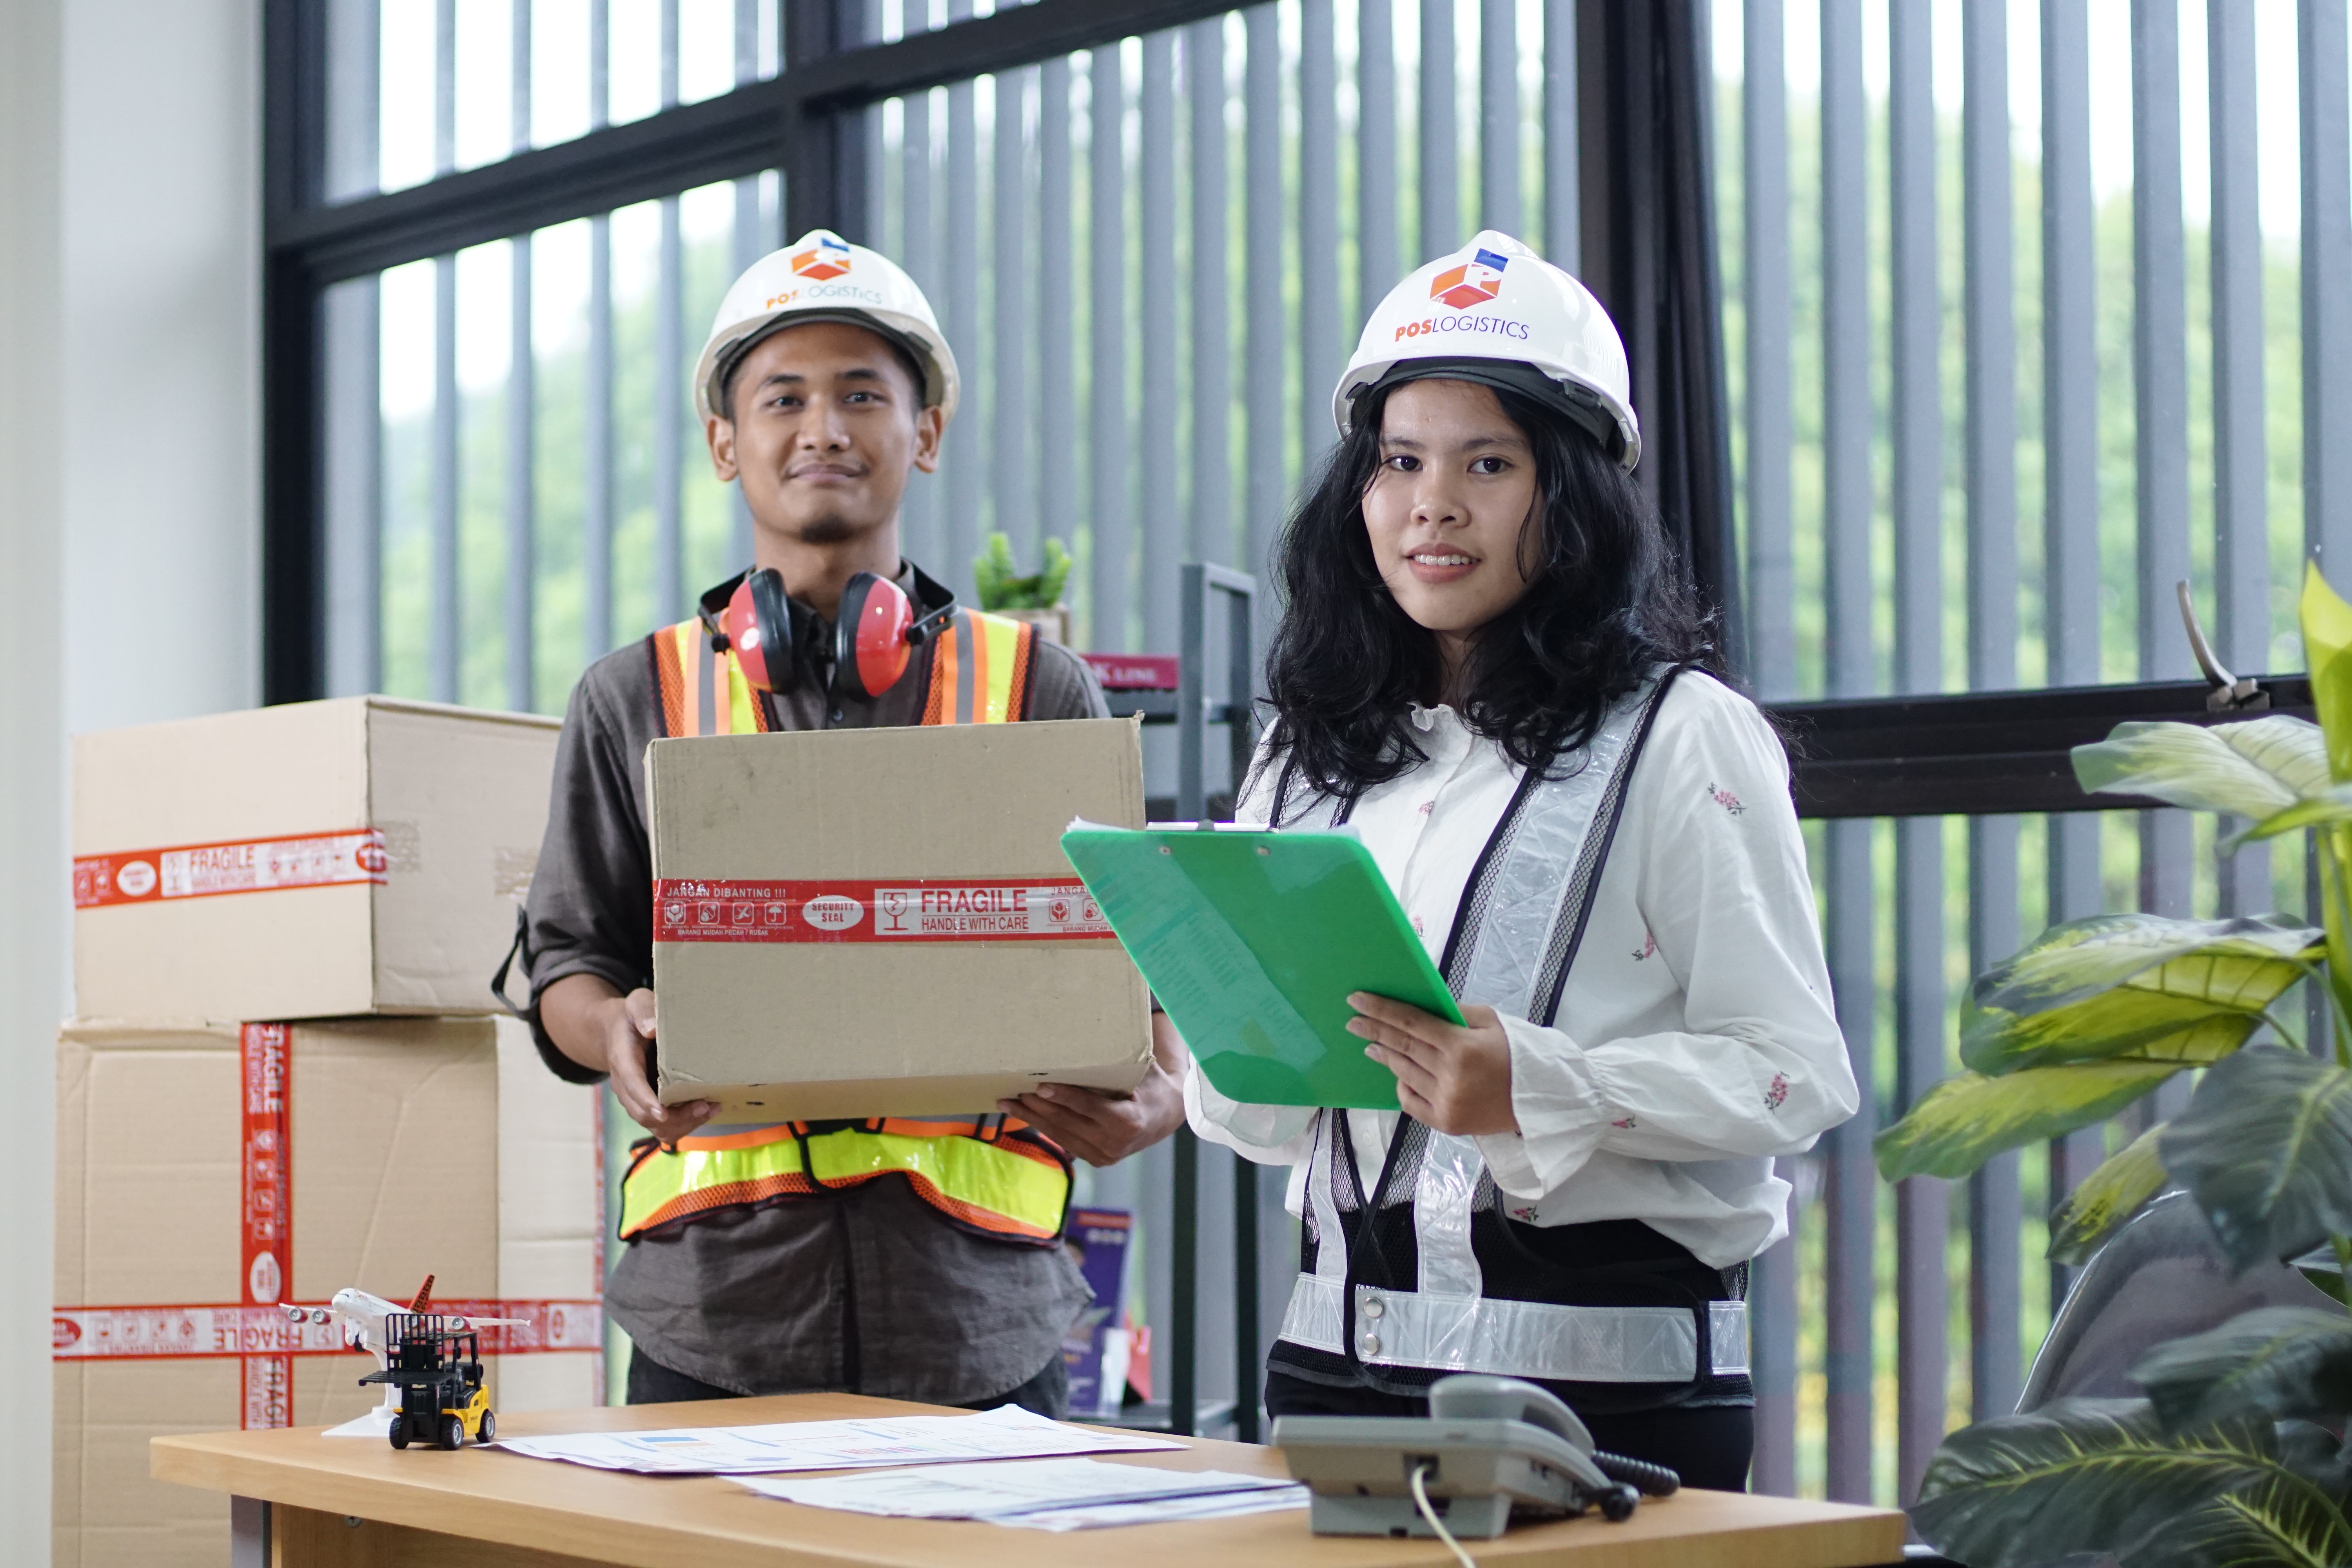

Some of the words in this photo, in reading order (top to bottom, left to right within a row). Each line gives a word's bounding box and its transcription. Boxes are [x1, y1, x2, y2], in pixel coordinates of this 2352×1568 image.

[190, 846, 255, 872] FRAGILE
[667, 887, 710, 897] JANGAN
[714, 888, 771, 898] DIBANTING
[922, 889, 1028, 913] FRAGILE
[812, 902, 854, 911] SECURITY
[822, 913, 844, 922] SEAL
[922, 917, 966, 931] HANDLE
[968, 917, 996, 931] WITH
[999, 916, 1029, 930] CARE
[263, 1024, 284, 1114] FRAGILE
[214, 1327, 303, 1350] FRAGILE
[265, 1357, 284, 1428] FRAGI
